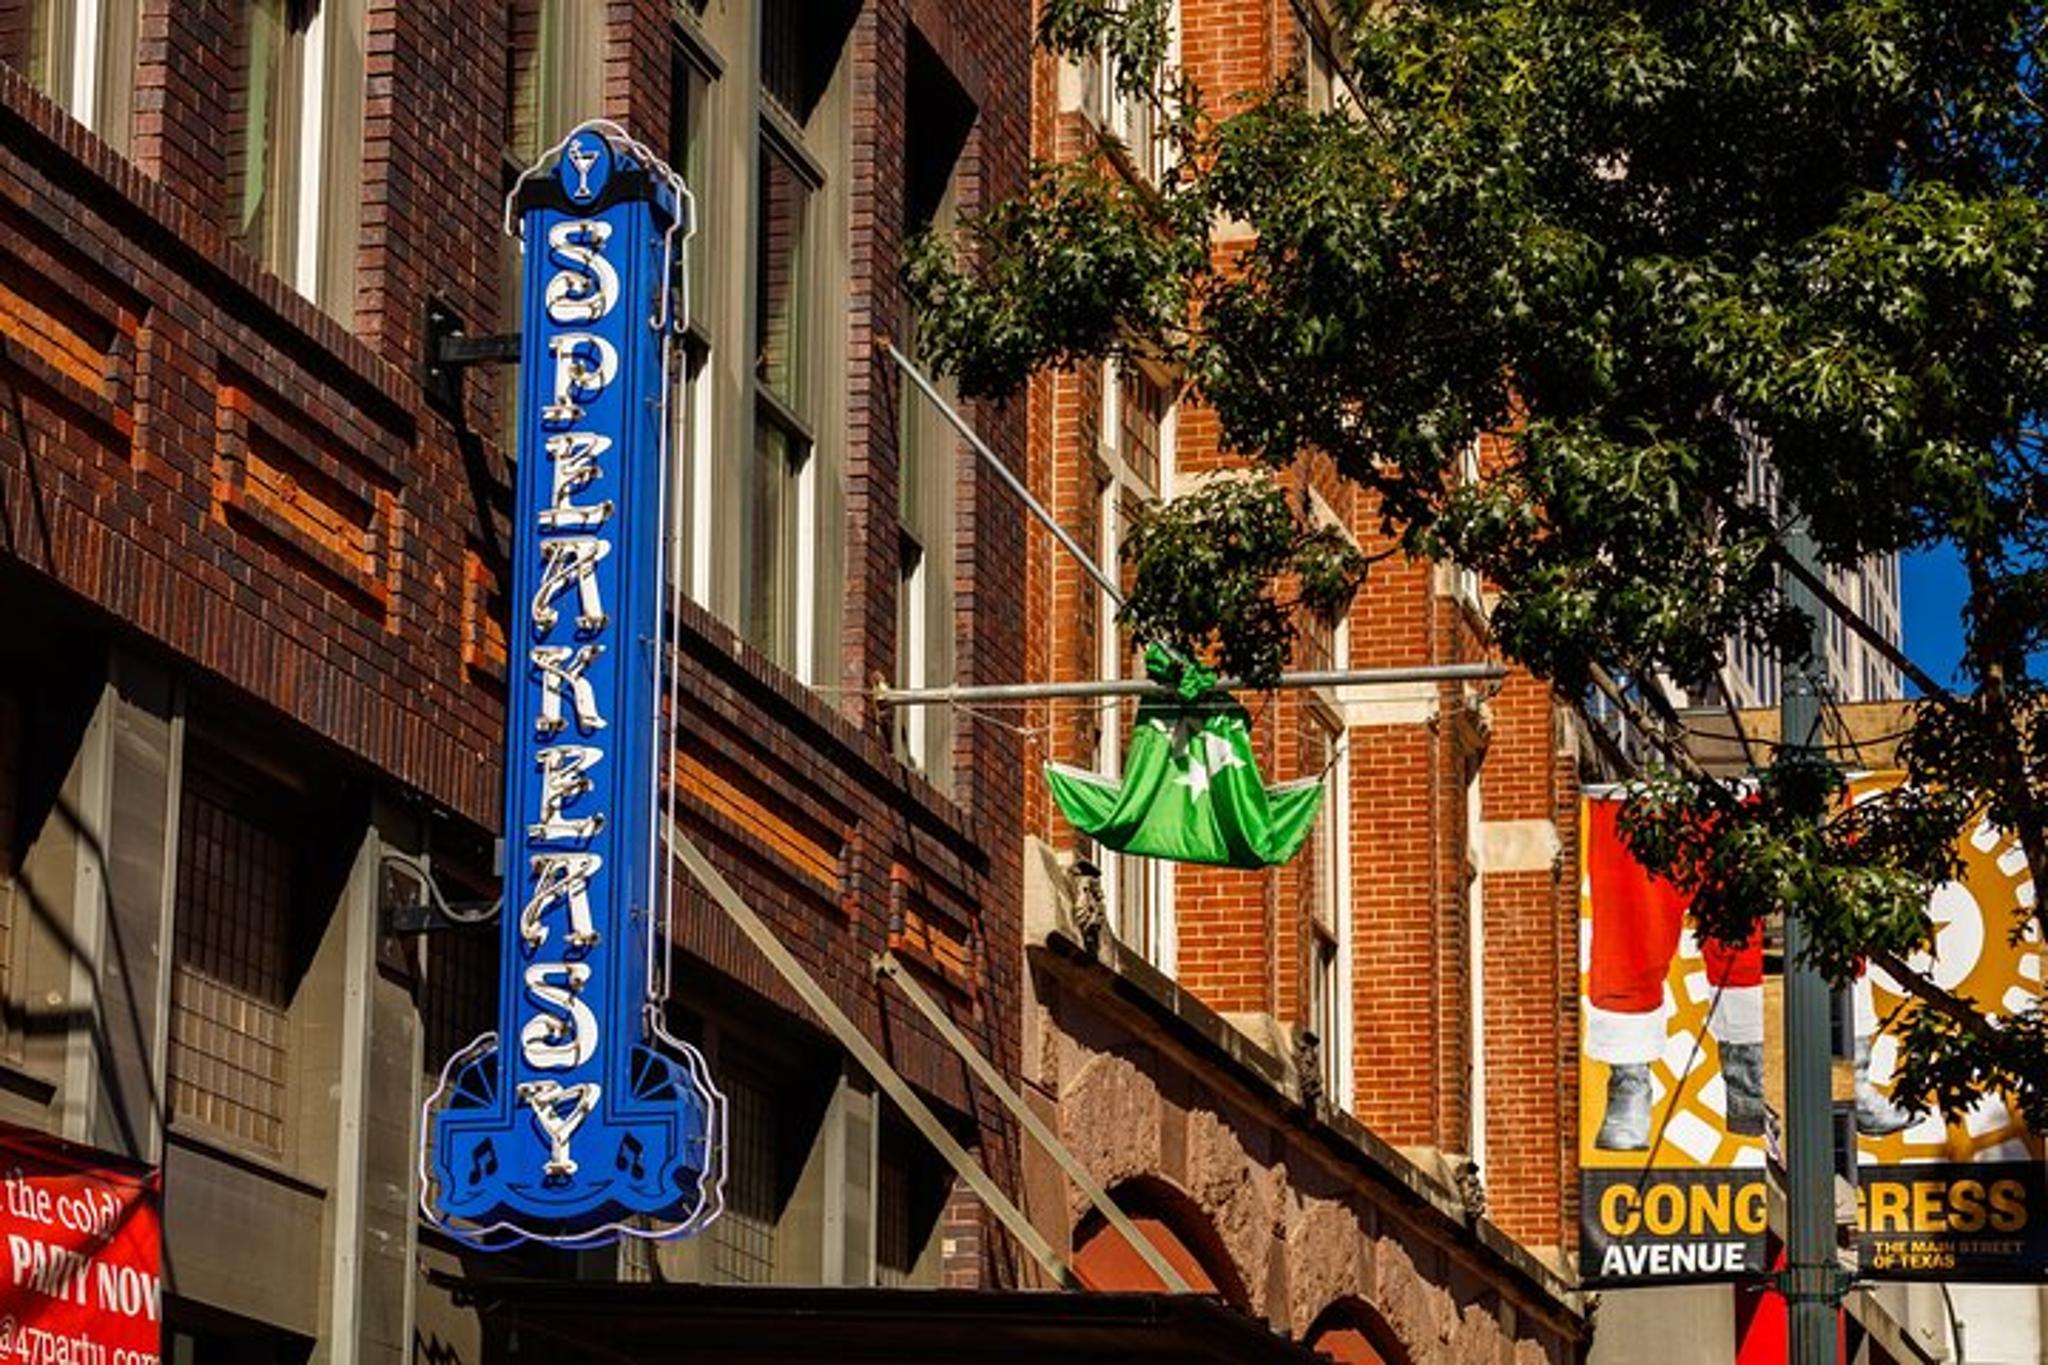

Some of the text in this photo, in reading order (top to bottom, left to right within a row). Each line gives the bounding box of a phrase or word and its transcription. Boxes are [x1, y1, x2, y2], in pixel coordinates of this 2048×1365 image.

[517, 219, 619, 1176] SPEAKEASY
[5, 1168, 54, 1225] the
[1601, 1182, 1767, 1236] CONG
[8, 1233, 92, 1306] PARTY
[1601, 1242, 1746, 1277] AVENUE
[1873, 1254, 1955, 1269] OF TEXAS
[1874, 1241, 2024, 1255] THE MAIN STREET
